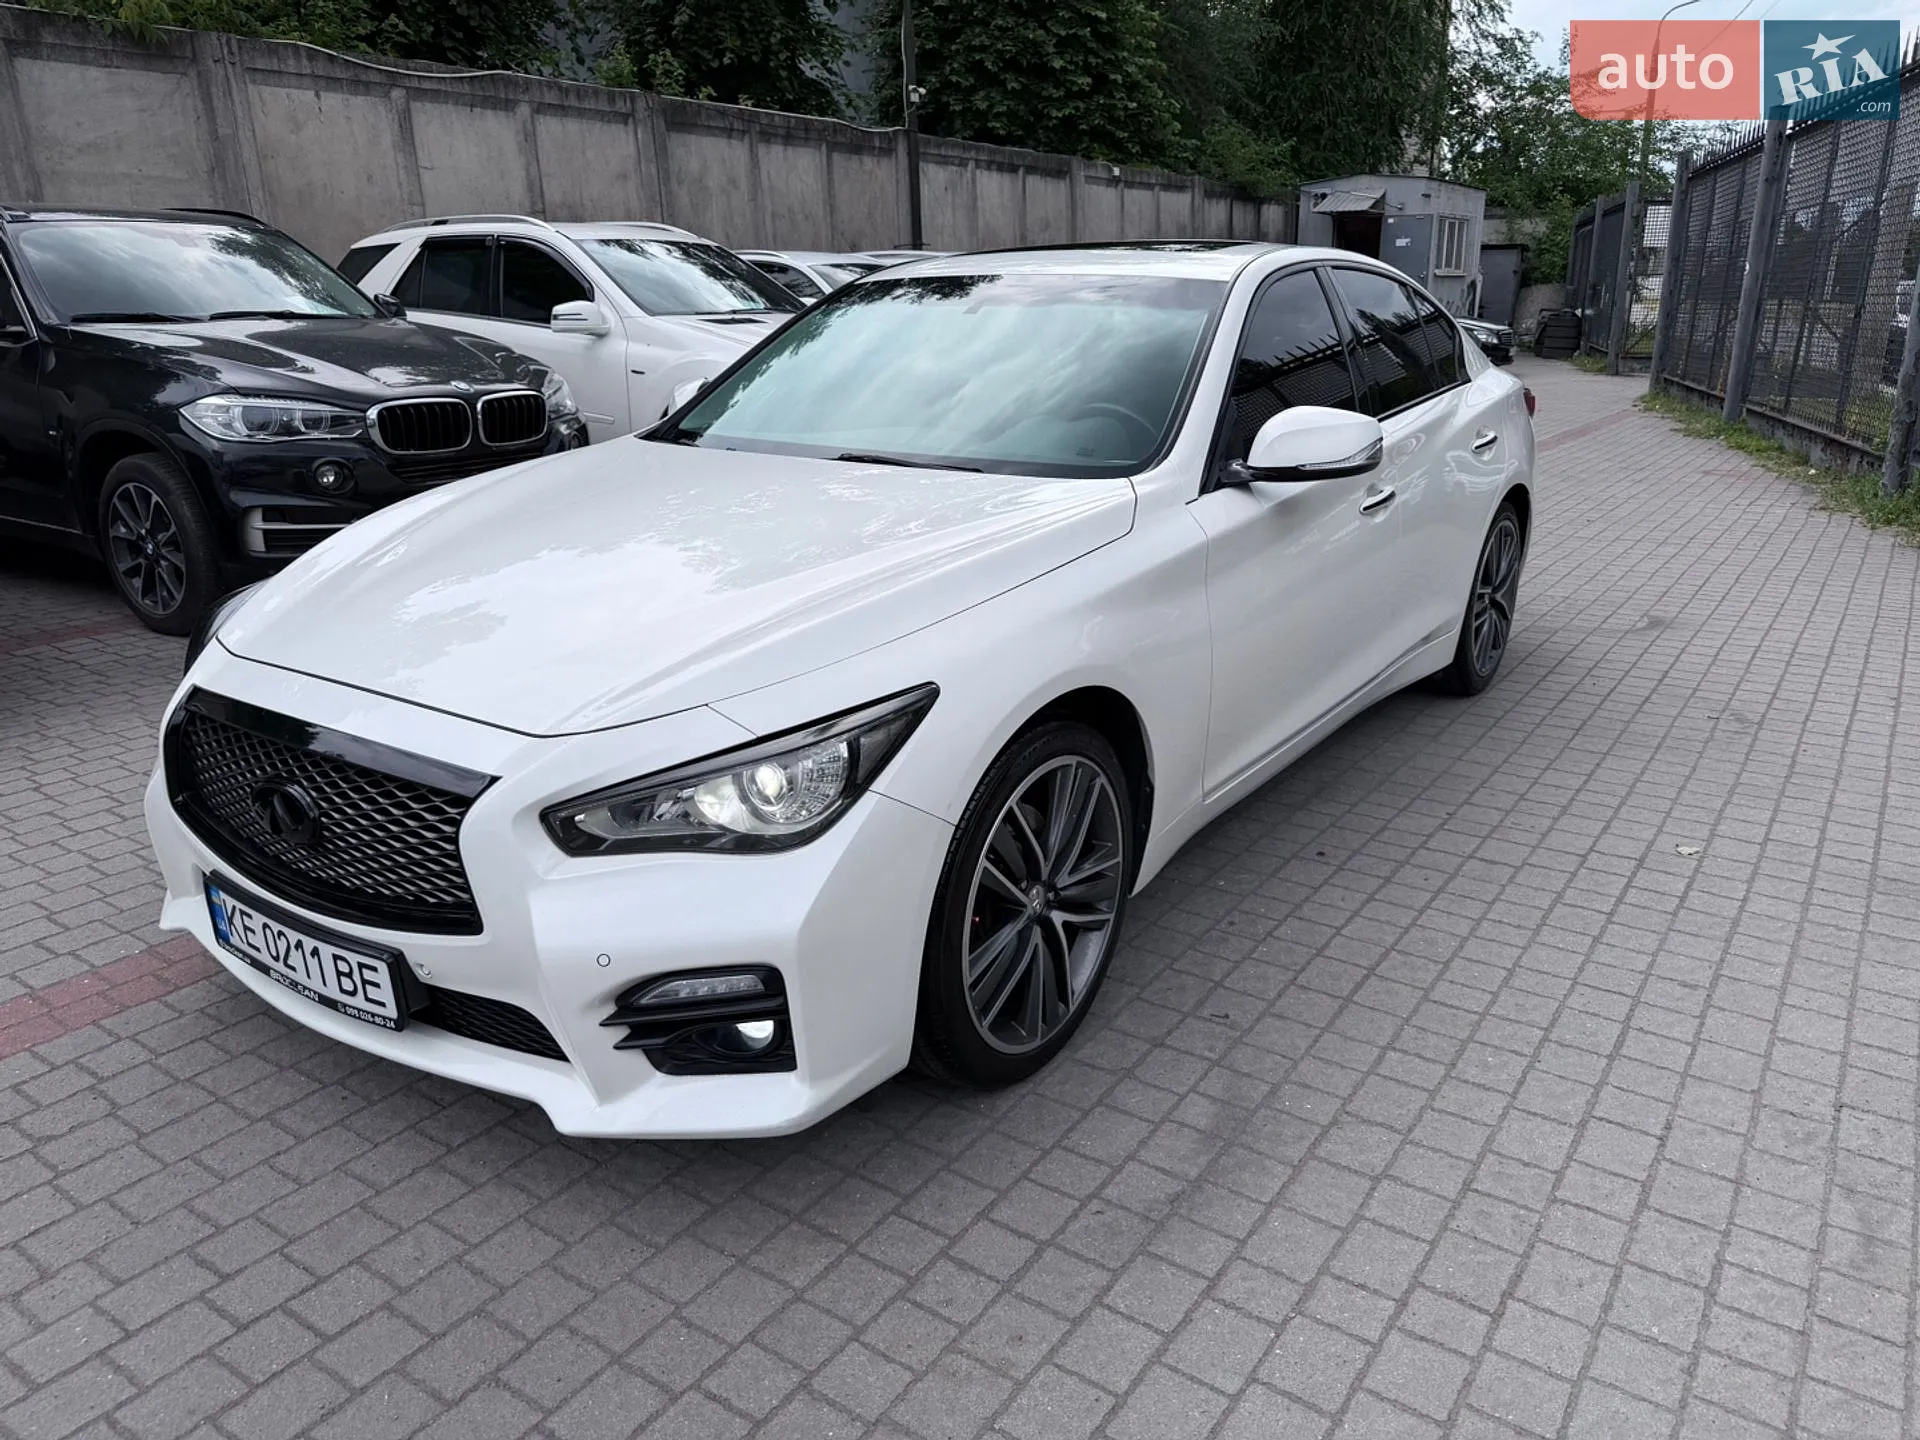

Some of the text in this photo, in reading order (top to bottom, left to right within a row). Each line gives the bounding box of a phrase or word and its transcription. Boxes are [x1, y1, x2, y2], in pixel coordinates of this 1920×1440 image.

[223, 899, 261, 953] KE
[262, 922, 327, 987] 0211
[332, 952, 386, 1008] BE
